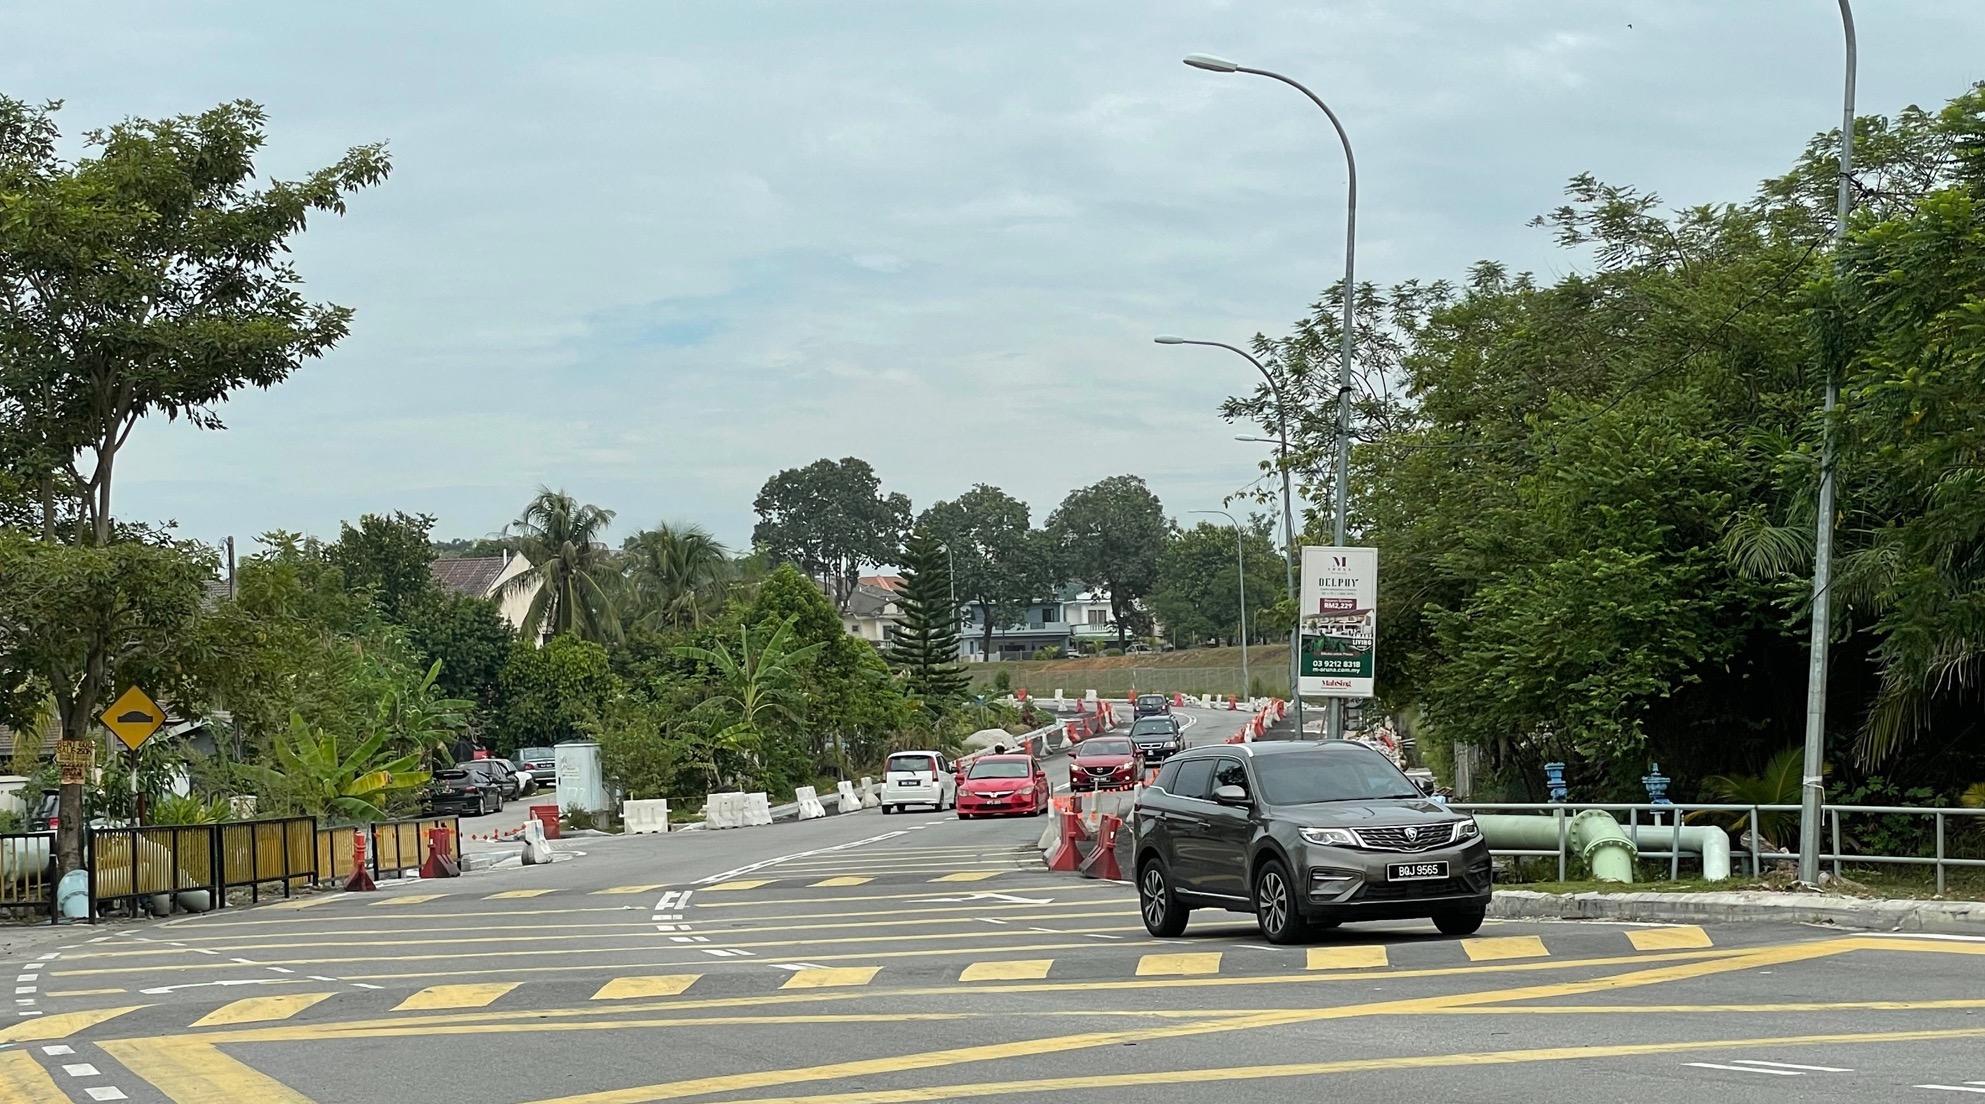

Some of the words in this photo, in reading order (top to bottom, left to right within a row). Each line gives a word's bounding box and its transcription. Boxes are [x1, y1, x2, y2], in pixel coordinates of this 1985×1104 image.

[1319, 578, 1356, 587] DELPHY
[1324, 660, 1341, 668] 9212
[1398, 865, 1415, 876] BQJ
[1416, 864, 1438, 876] 9565
